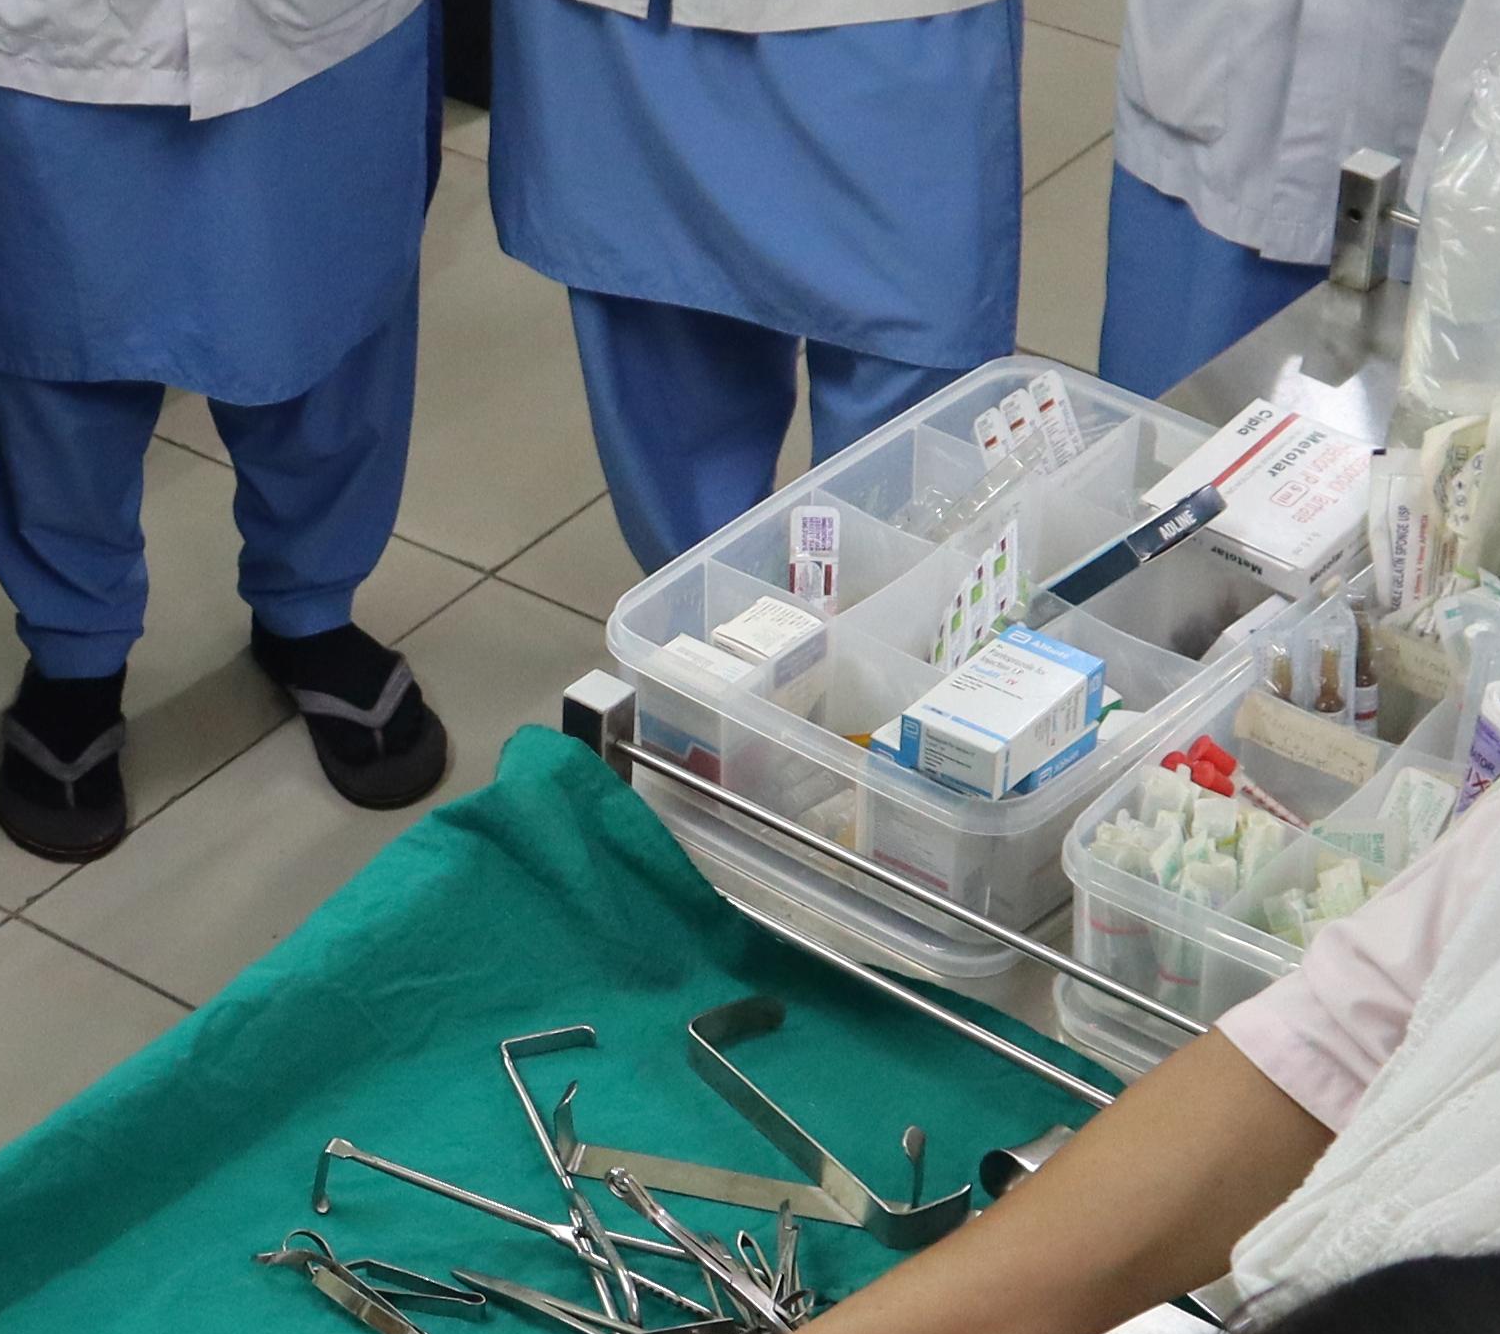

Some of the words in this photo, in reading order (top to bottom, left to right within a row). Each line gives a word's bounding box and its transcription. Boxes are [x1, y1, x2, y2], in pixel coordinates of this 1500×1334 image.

[1237, 409, 1273, 436] Cipla
[1268, 430, 1327, 478] Metolar
[1159, 509, 1198, 542] ADLINE
[1395, 523, 1410, 556] SPONGE
[1211, 545, 1264, 576] Metolar
